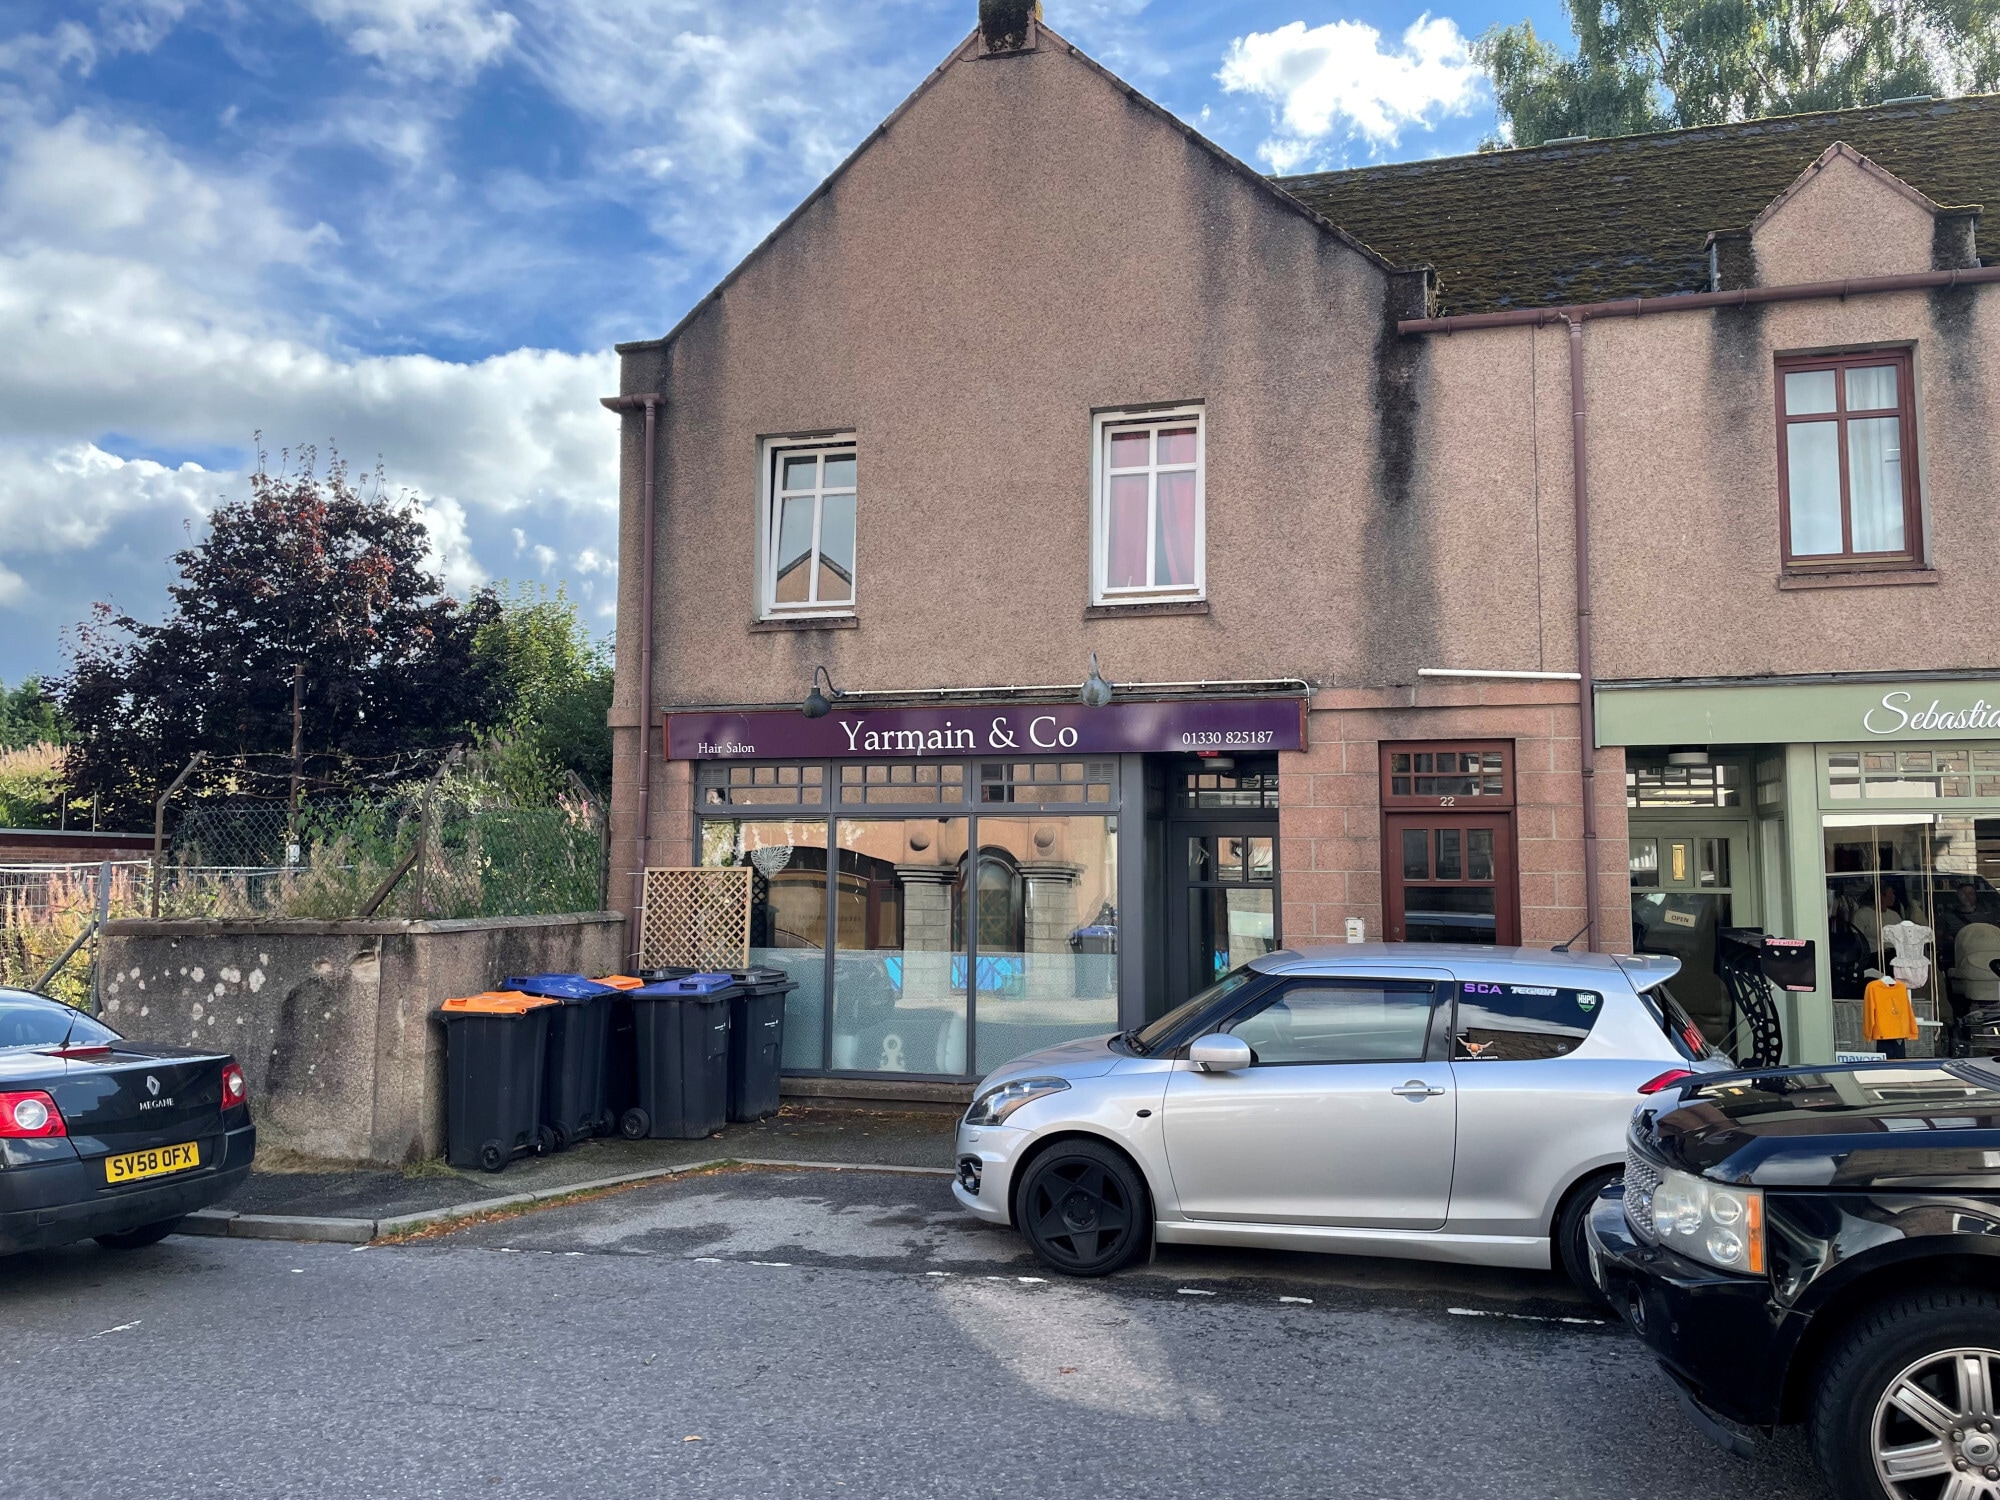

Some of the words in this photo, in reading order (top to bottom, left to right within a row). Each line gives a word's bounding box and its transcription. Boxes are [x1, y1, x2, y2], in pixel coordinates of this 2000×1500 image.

[839, 721, 976, 751] Yarmain
[988, 717, 1020, 748] &
[1029, 716, 1079, 748] Co
[1182, 732, 1221, 745] 01330
[1225, 731, 1273, 744] 825187
[698, 742, 722, 754] Hair
[726, 742, 755, 753] Salon
[1440, 796, 1455, 806] 22
[1671, 915, 1689, 923] OPEN
[1464, 983, 1503, 995] SCA
[140, 1098, 174, 1111] MEGANE
[113, 1153, 157, 1176] SV58
[162, 1145, 191, 1167] OFX
